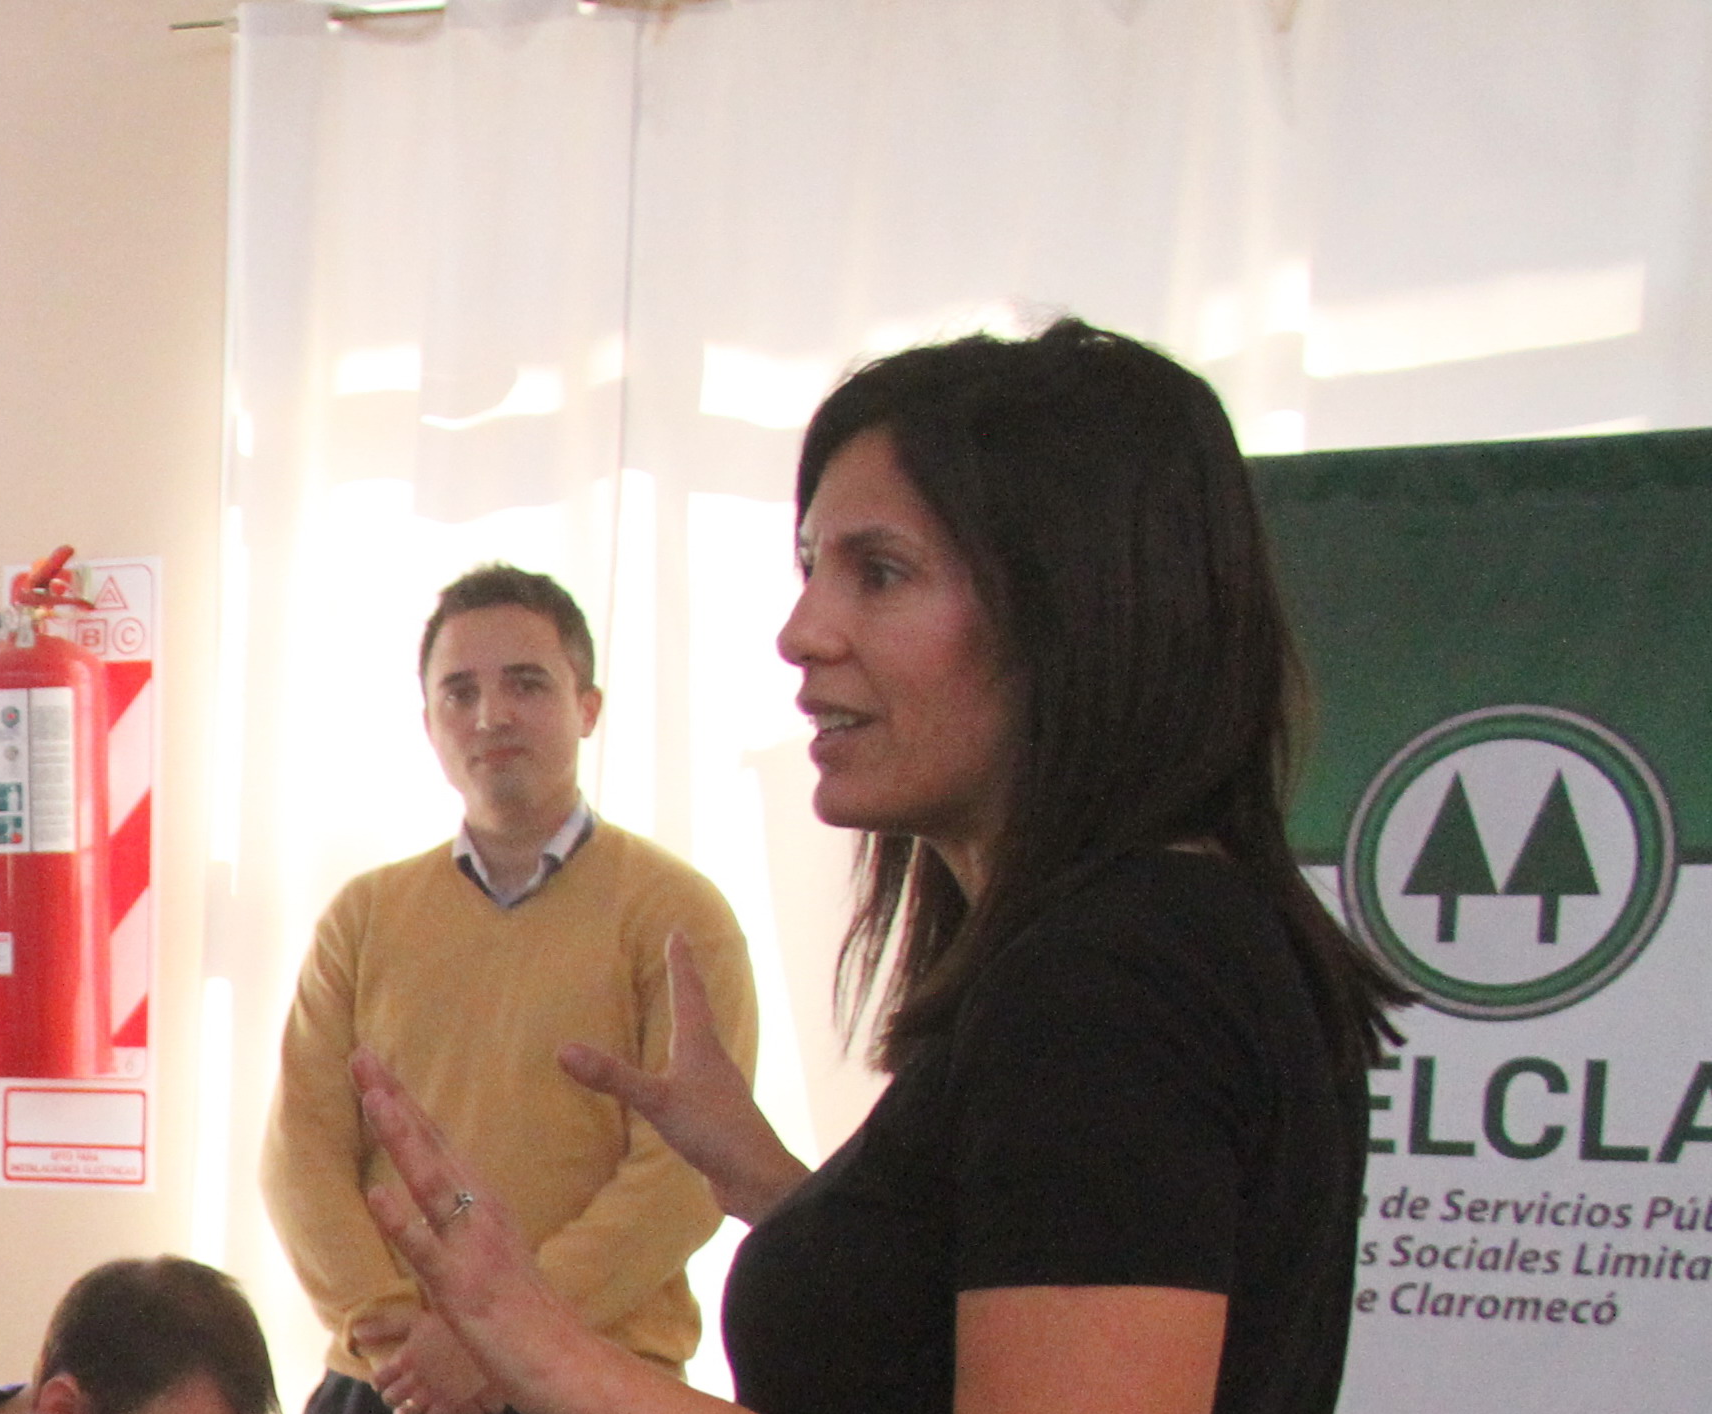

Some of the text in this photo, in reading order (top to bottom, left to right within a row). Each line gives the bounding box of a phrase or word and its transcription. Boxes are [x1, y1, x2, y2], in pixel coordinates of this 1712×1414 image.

[121, 626, 136, 646] C
[1379, 1186, 1429, 1220] de
[1440, 1189, 1632, 1230] Servicios
[1389, 1234, 1561, 1277] Sociales
[1573, 1243, 1712, 1281] Limita
[1389, 1281, 1619, 1327] Claromecó
